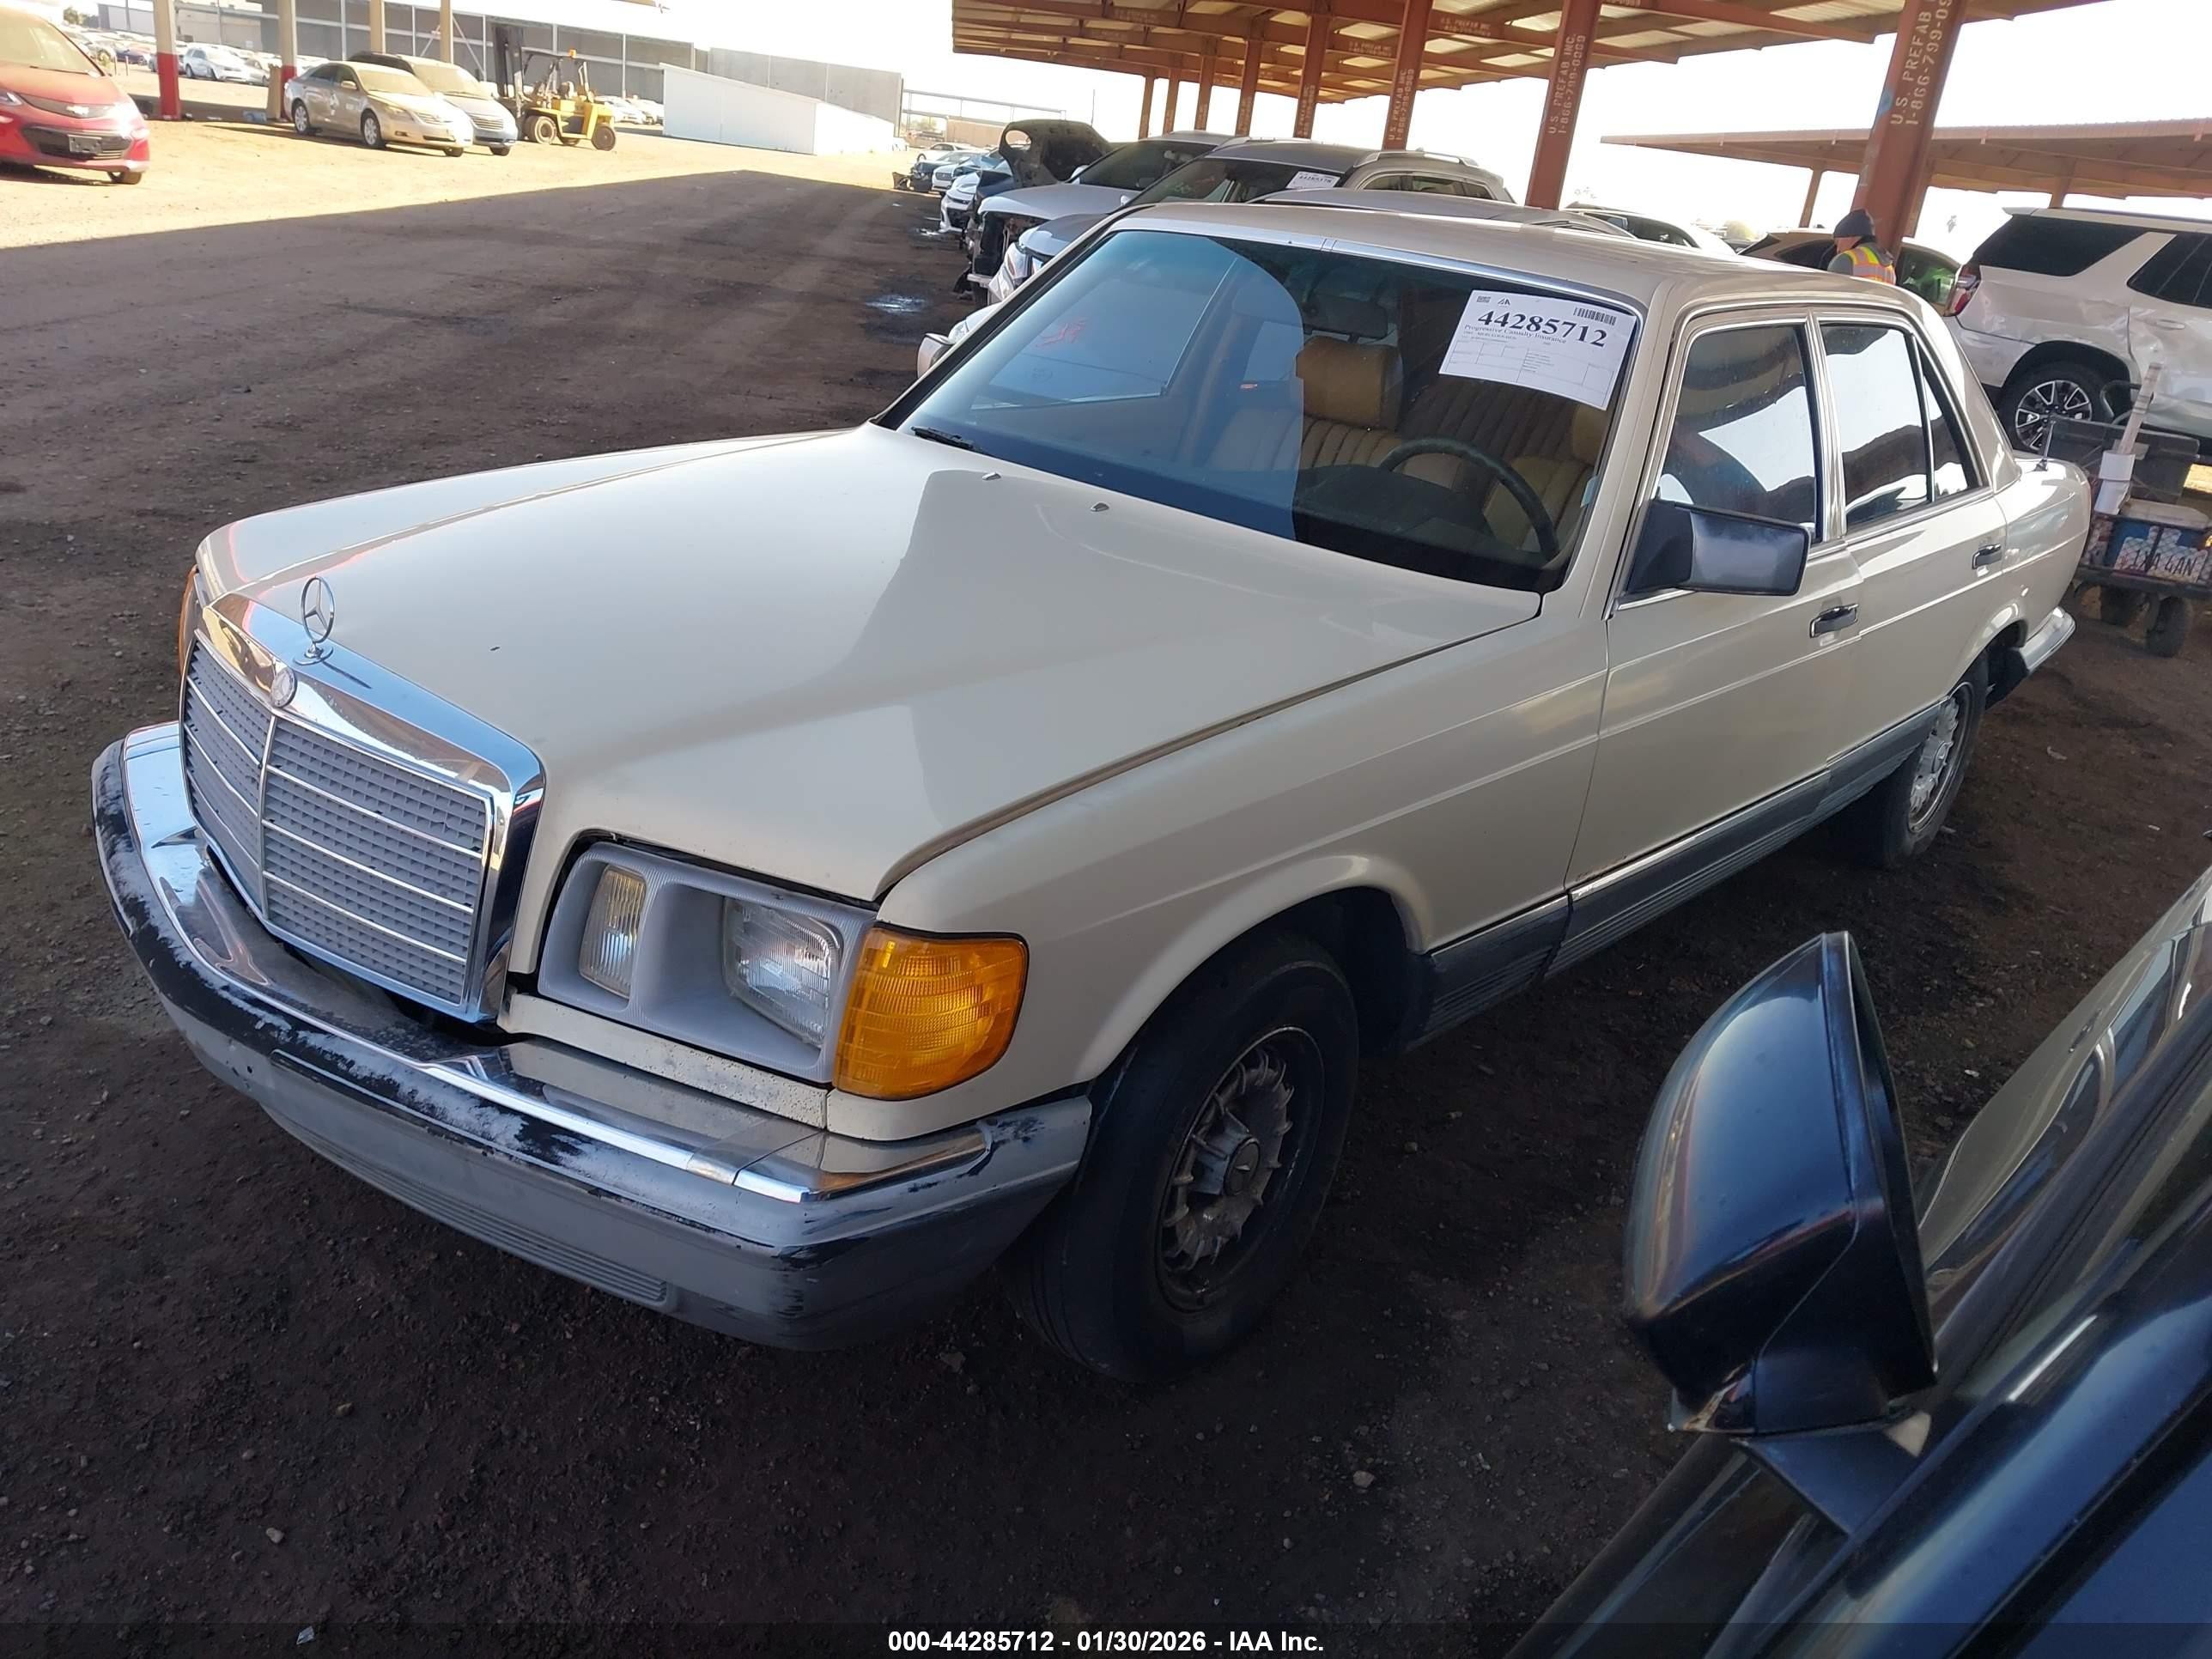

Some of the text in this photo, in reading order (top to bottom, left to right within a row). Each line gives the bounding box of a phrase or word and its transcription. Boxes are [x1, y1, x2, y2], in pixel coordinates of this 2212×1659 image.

[1553, 61, 1571, 106] PREFAB
[1890, 11, 1932, 125] U.S. PREFAB
[1464, 324, 1503, 333] Progressive
[1504, 327, 1533, 338] Casualty
[1534, 331, 1567, 343] Insurance
[1478, 310, 1607, 348] 44285712
